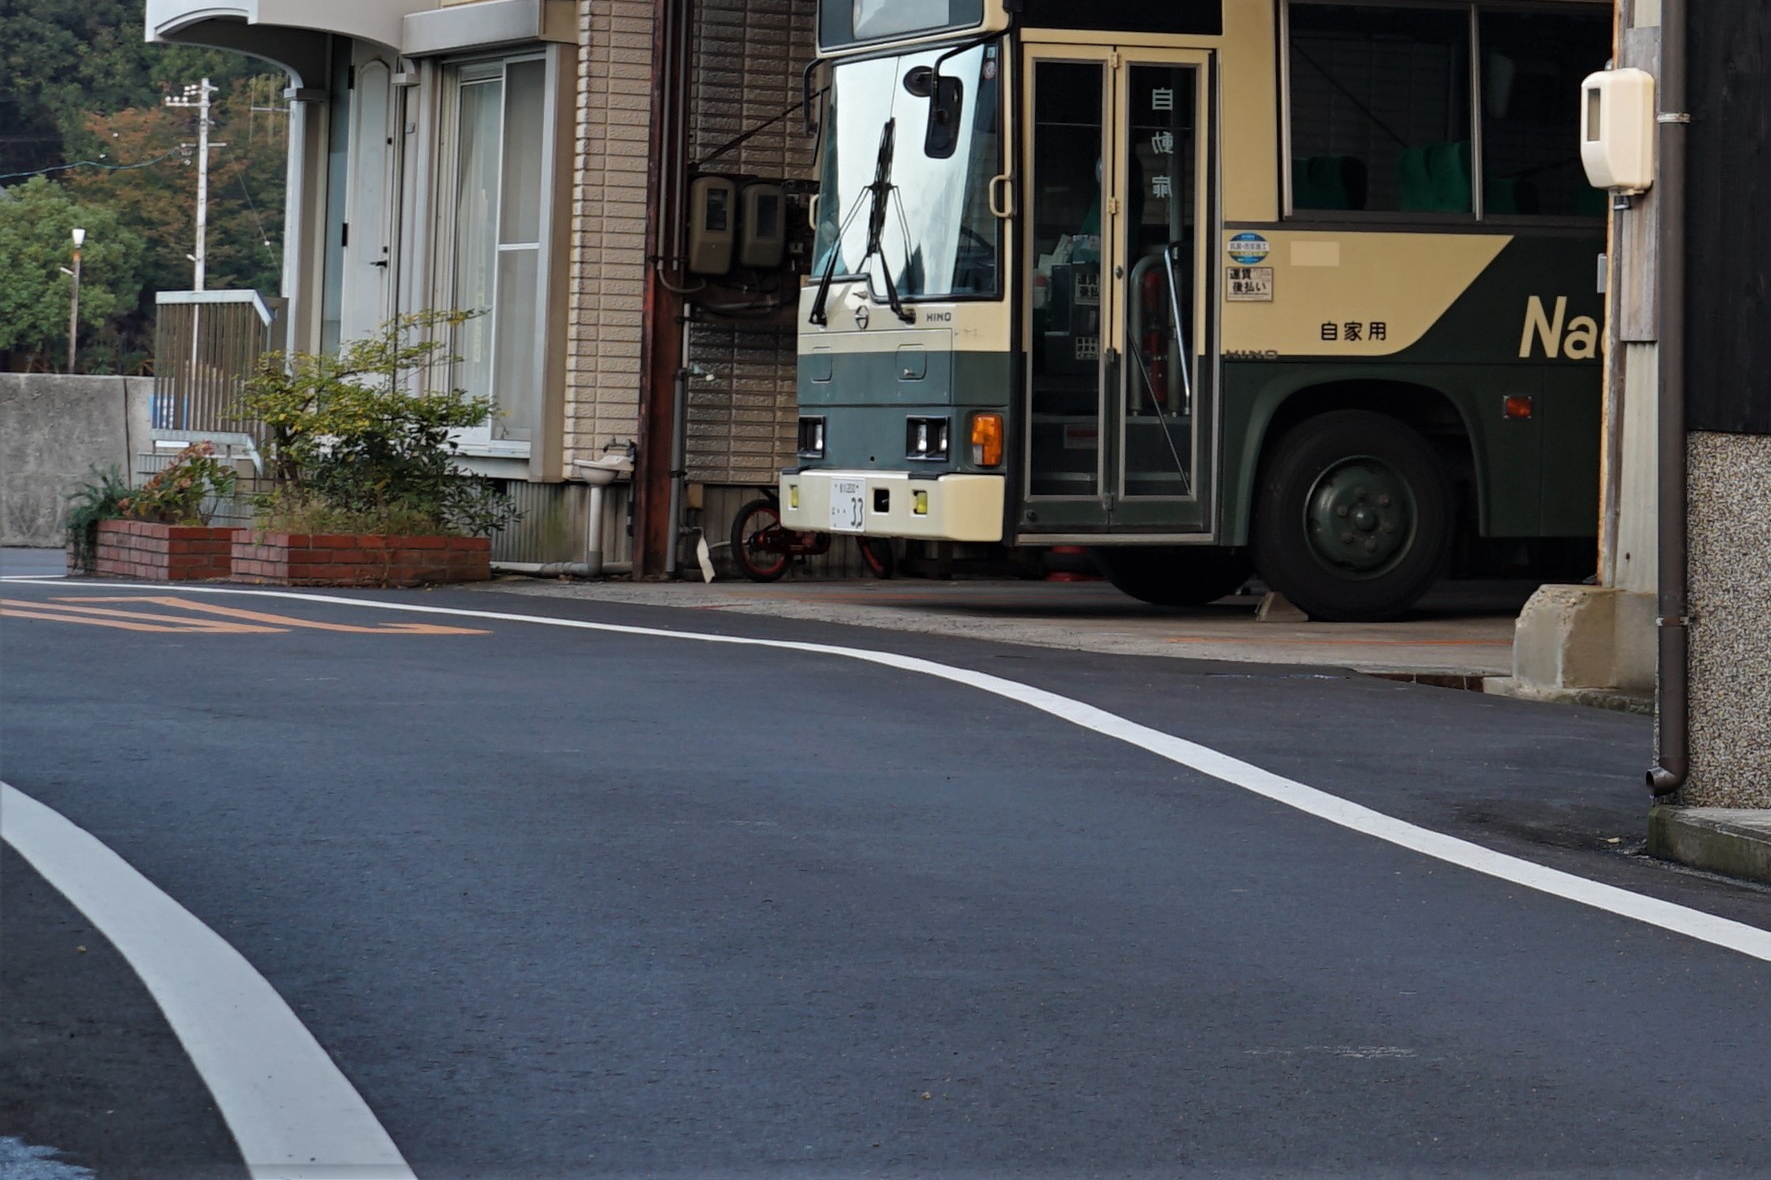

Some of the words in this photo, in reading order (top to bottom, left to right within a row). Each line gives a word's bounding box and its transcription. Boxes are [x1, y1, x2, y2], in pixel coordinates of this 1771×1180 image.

[926, 312, 951, 322] HINO
[1320, 321, 1387, 341] 自家用
[1518, 295, 1605, 360] Na
